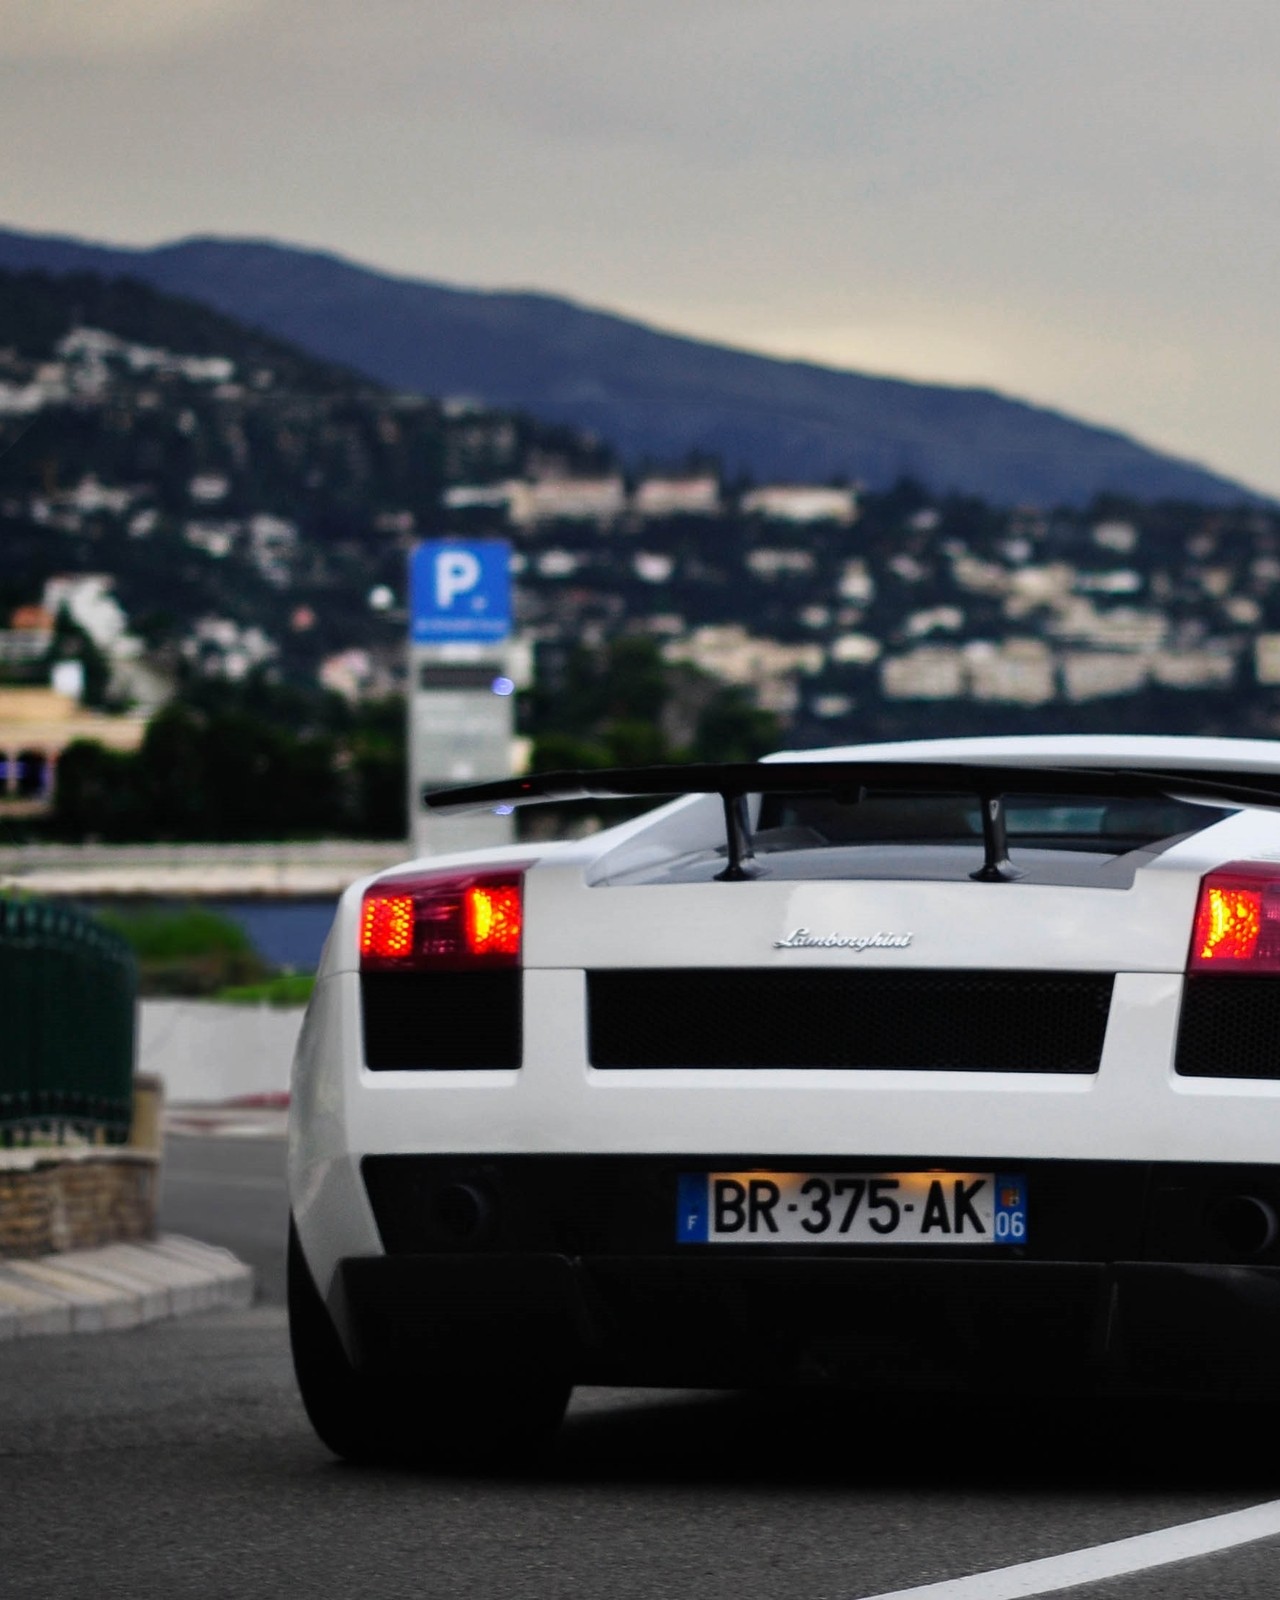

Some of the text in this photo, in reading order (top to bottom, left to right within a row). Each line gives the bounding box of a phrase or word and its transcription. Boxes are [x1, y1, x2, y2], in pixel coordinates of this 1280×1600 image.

[774, 929, 913, 952] Lamborghini
[688, 1179, 1025, 1237] F BR-375-AK 06
